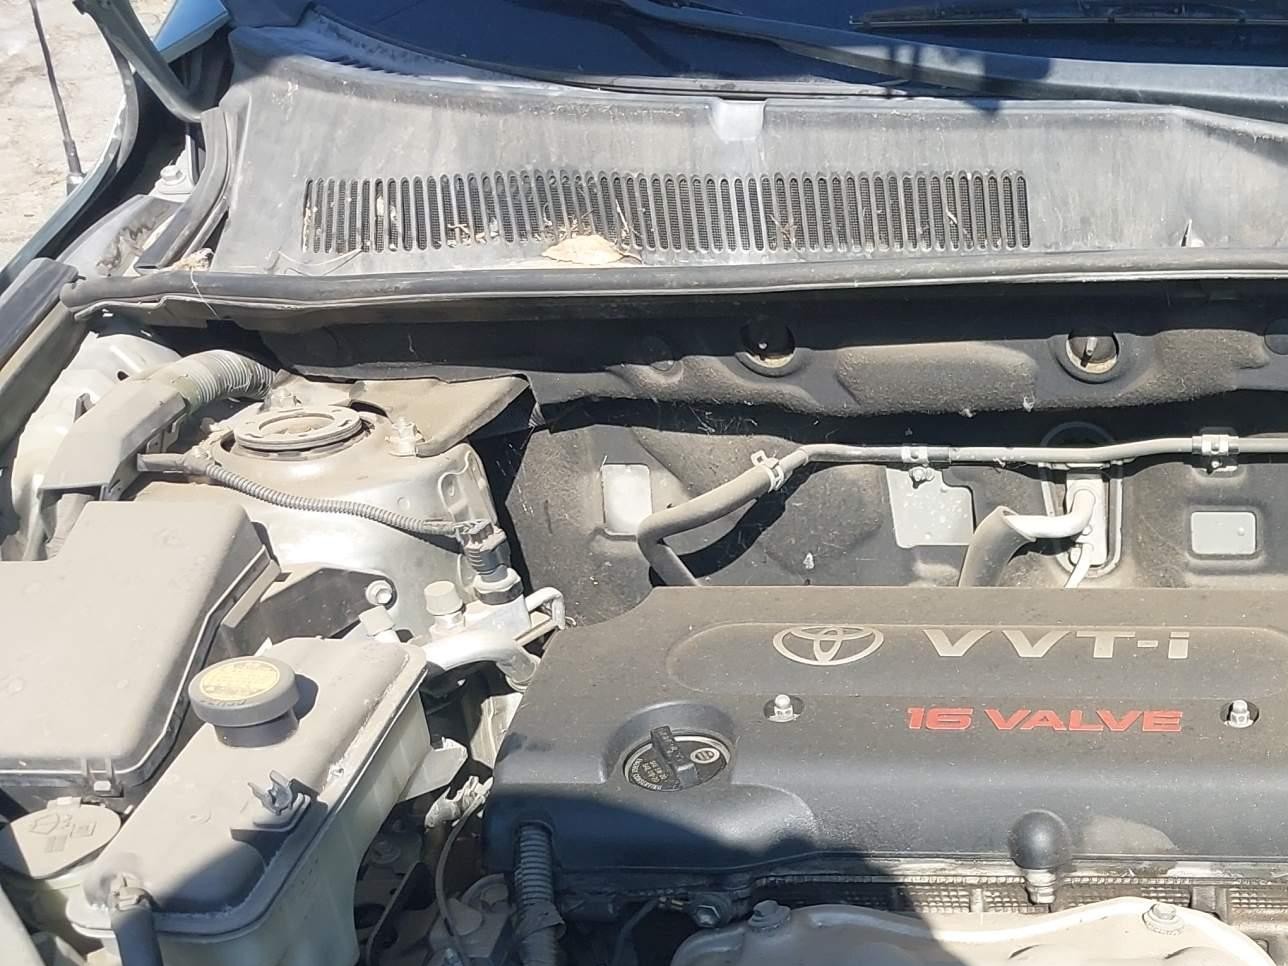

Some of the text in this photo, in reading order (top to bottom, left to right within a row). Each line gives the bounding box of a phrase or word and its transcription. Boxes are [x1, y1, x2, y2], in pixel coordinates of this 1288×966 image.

[922, 629, 1189, 659] VVT-i
[907, 708, 1184, 733] 16 VALVE
